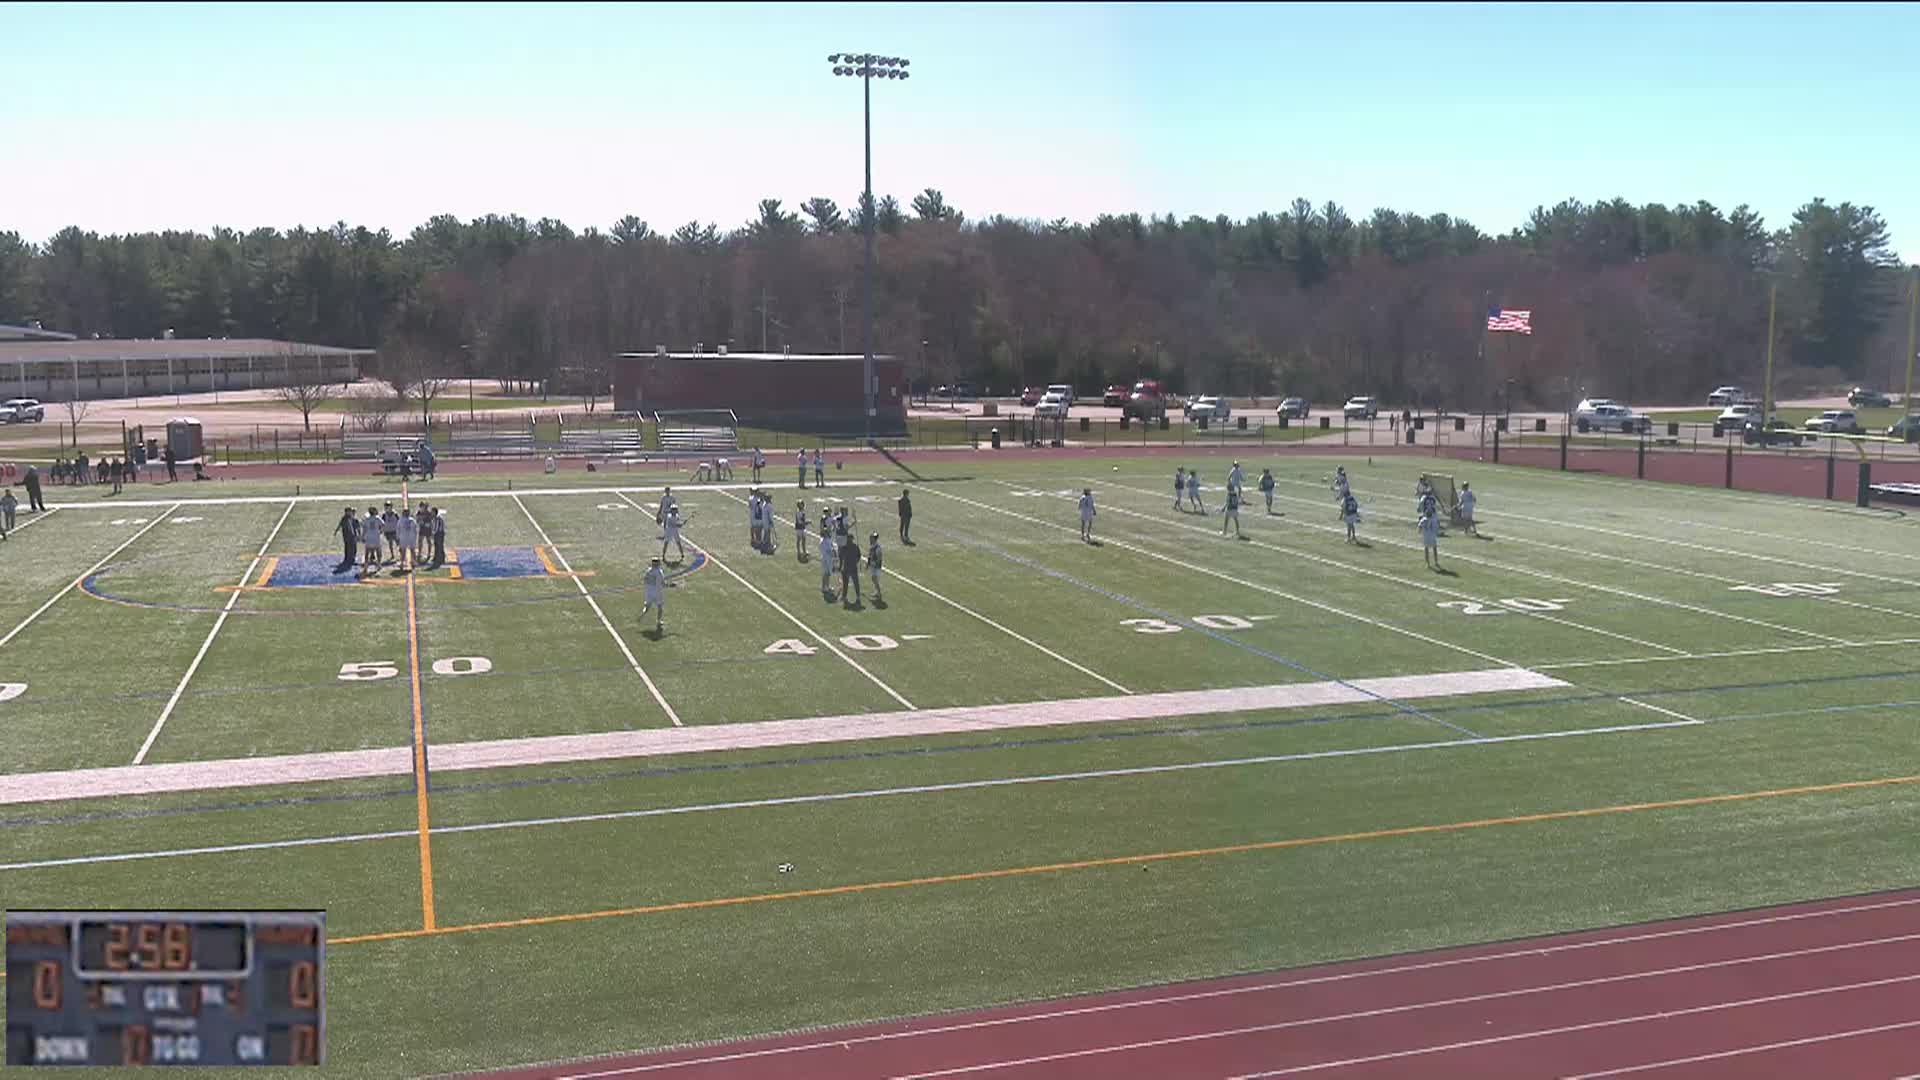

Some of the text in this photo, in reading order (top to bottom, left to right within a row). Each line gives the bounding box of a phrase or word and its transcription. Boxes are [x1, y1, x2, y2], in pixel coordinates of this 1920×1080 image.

[1436, 598, 1564, 615] 20
[1119, 614, 1254, 633] 30
[763, 634, 899, 656] 40
[337, 656, 493, 680] 50
